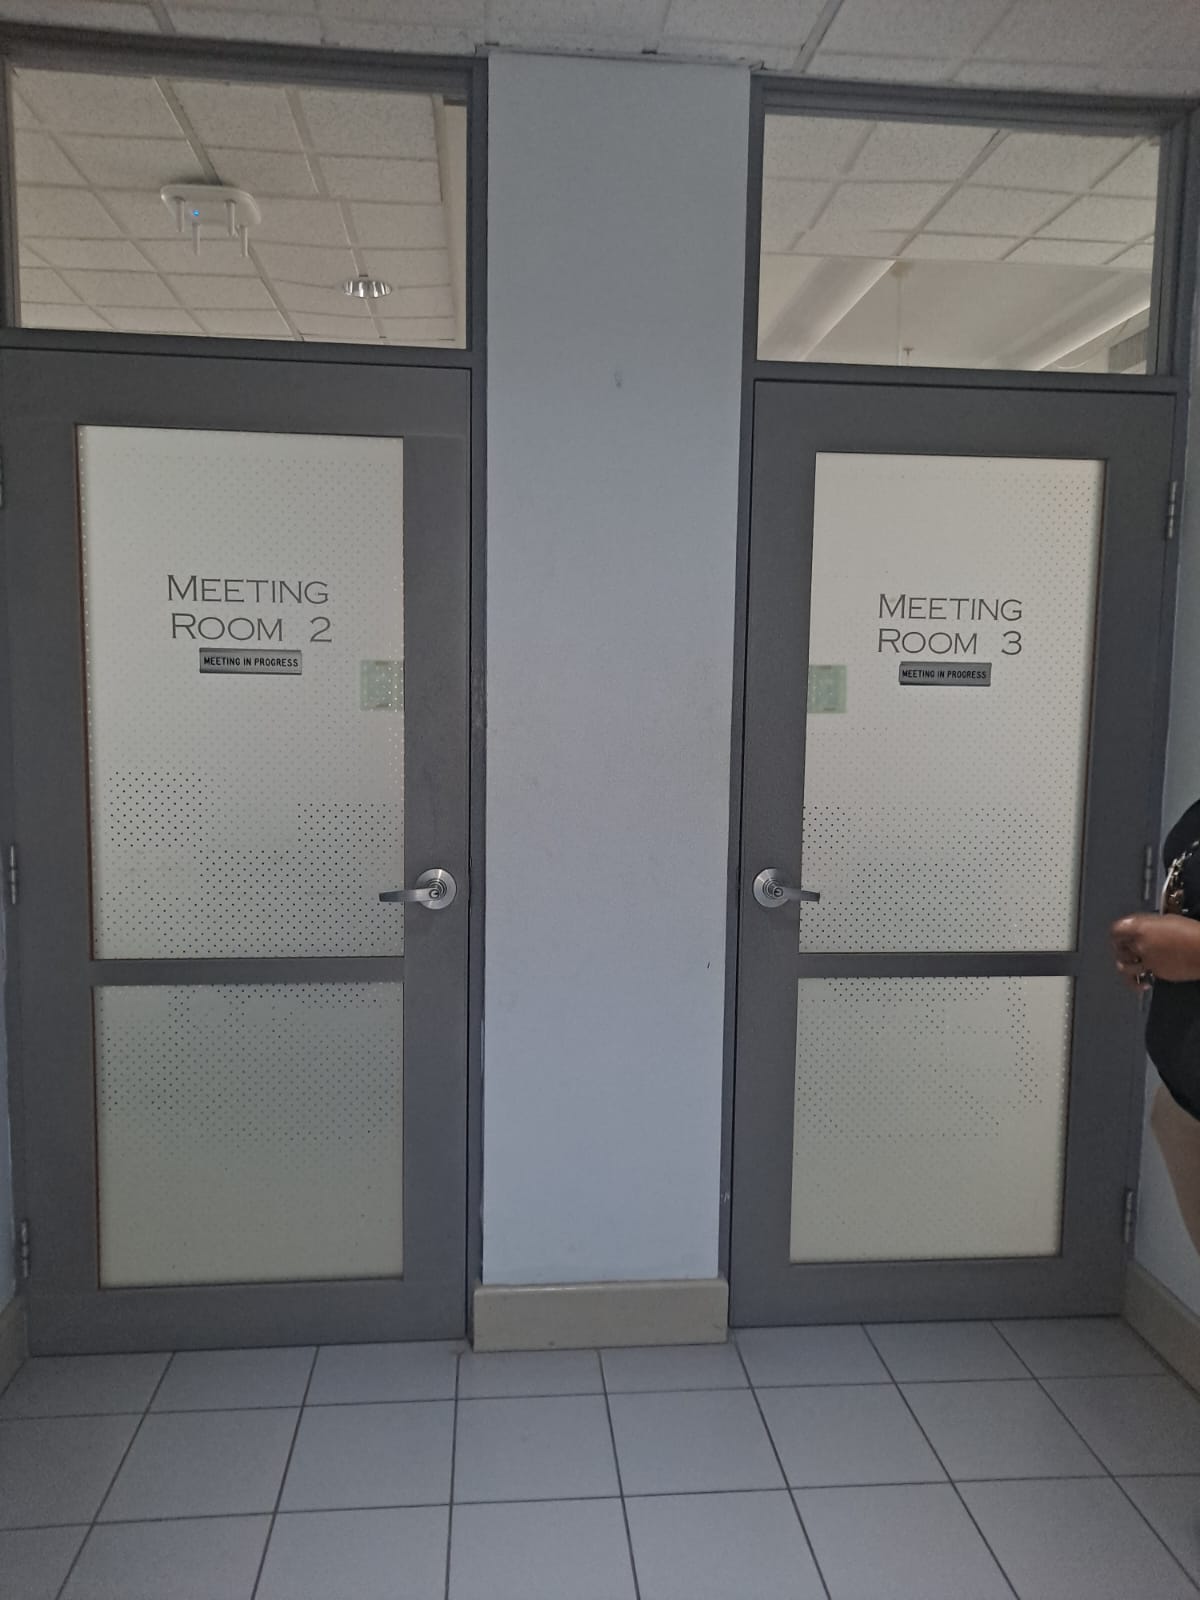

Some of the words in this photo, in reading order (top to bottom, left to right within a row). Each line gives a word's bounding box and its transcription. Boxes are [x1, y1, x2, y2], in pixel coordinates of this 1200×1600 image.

[168, 574, 329, 604] MEETING
[879, 594, 1022, 621] MEETING
[171, 612, 283, 642] ROOM
[310, 616, 332, 642] 2
[878, 629, 977, 654] ROOM
[1001, 631, 1022, 655] 3
[203, 656, 241, 667] MEETING
[243, 657, 252, 667] IN
[254, 657, 298, 667] PROGRESS
[902, 669, 935, 679] MEETING
[937, 670, 945, 679] IN
[947, 670, 986, 679] PROGRESS
